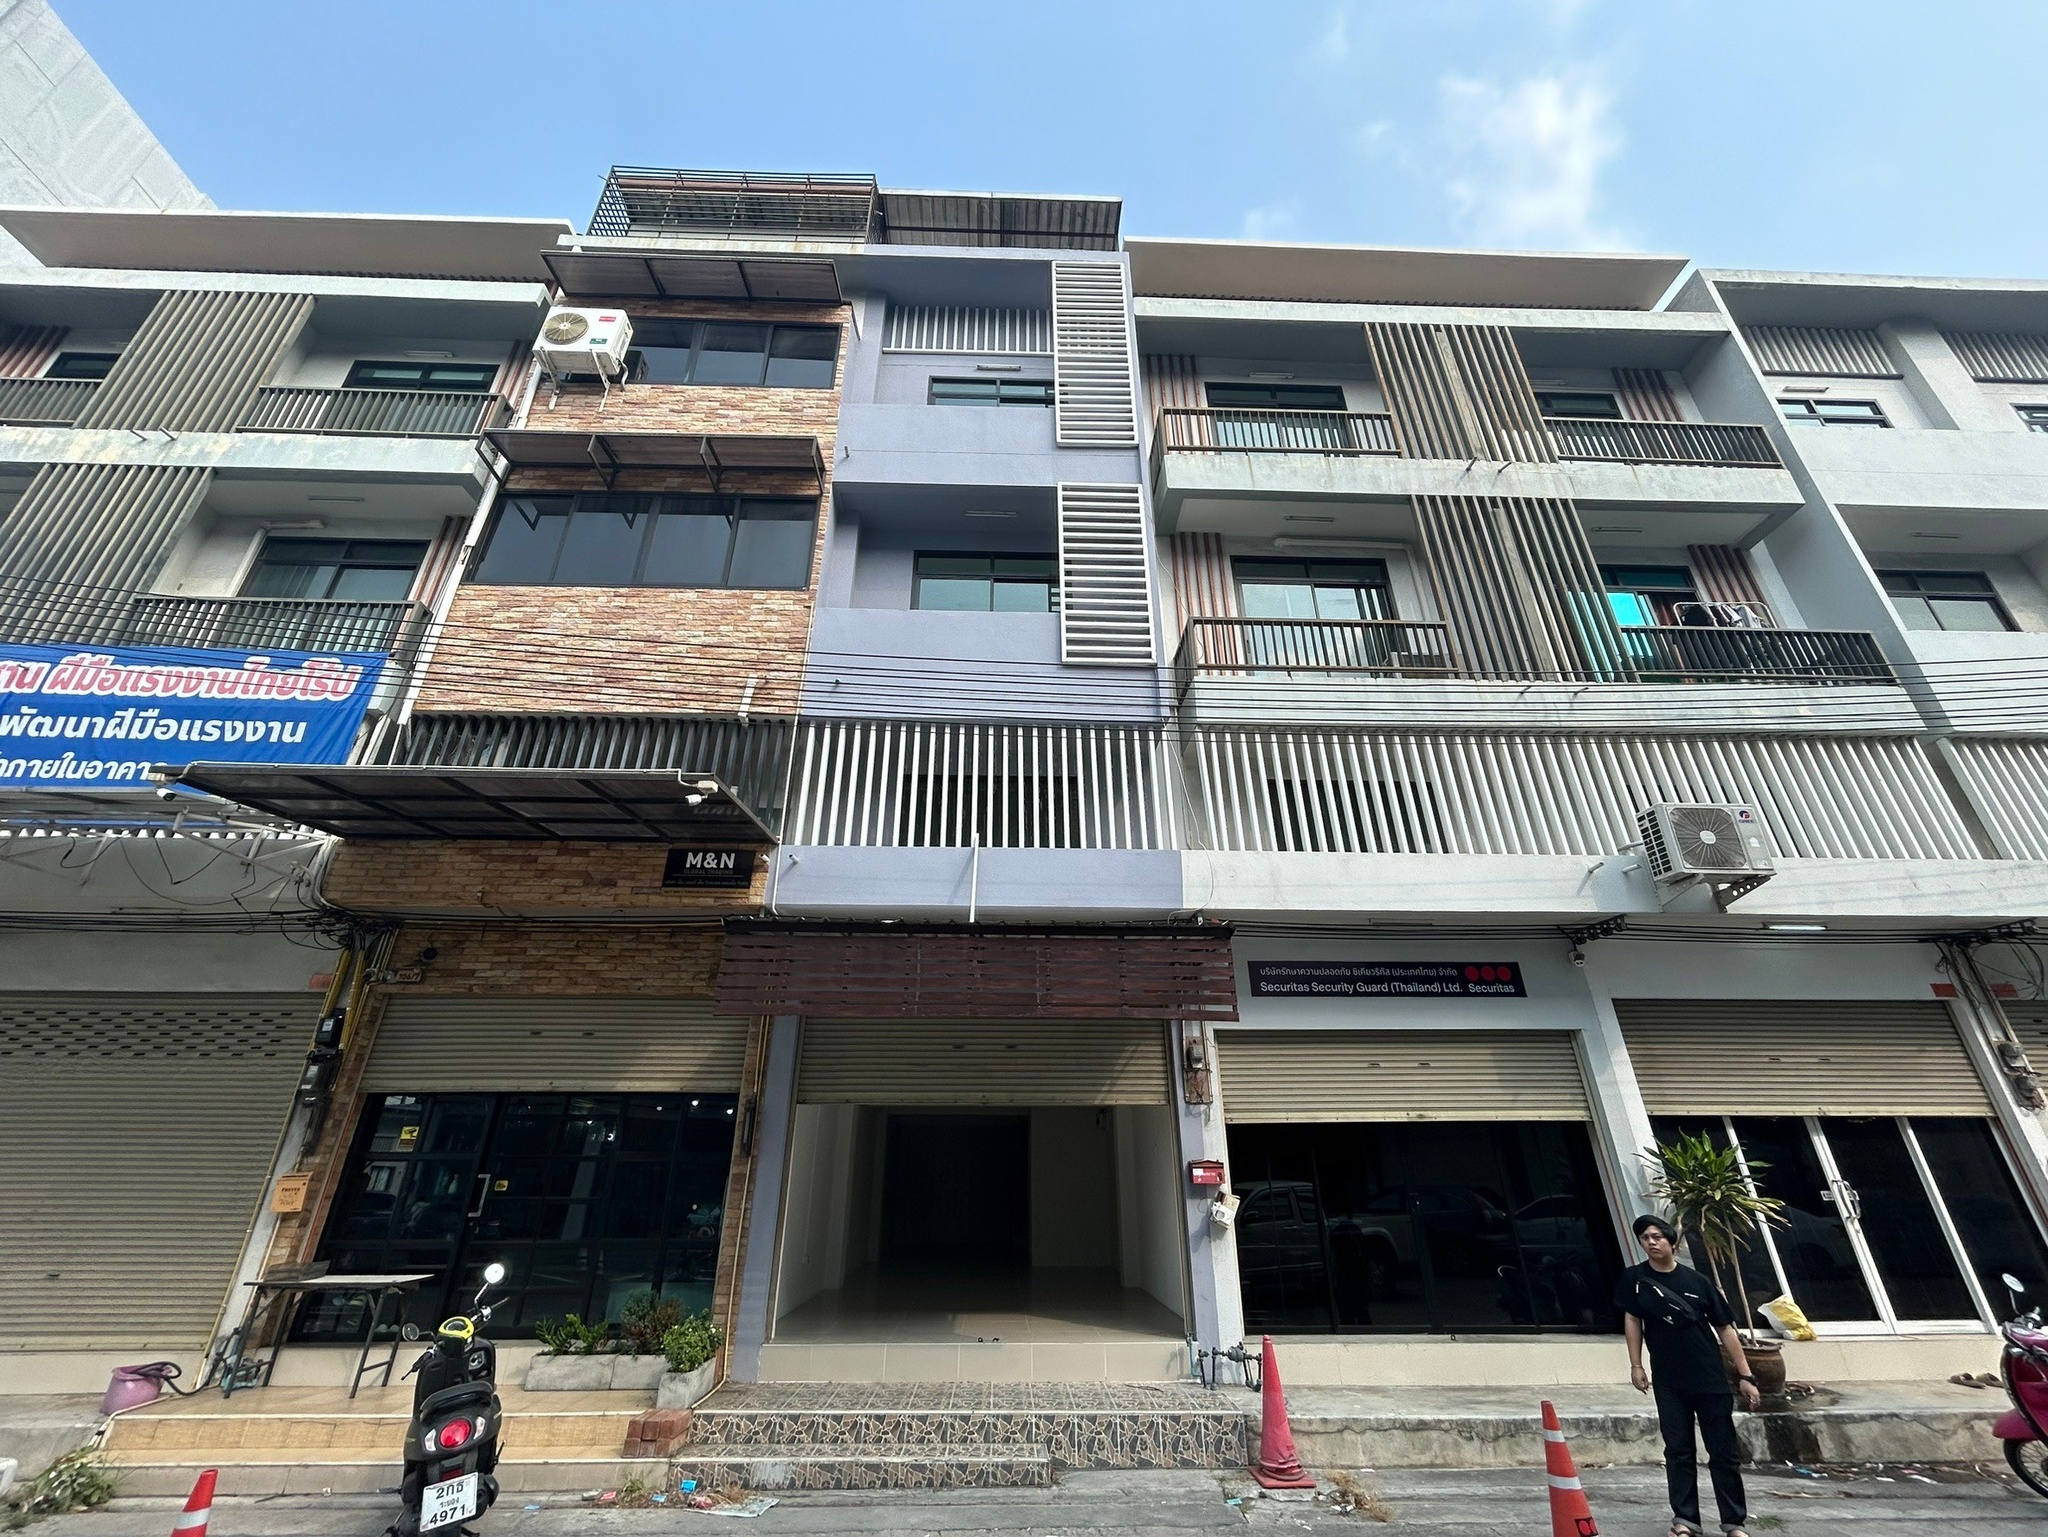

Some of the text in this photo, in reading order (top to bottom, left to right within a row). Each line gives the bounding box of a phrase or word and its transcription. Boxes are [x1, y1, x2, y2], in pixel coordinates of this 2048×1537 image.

[685, 852, 736, 868] M&N
[1391, 966, 1437, 977] (ประเทศไทย)
[1438, 967, 1458, 976] จำกัด
[1260, 981, 1463, 994] Securitas Security Guard (Thailand) Ltd.
[1468, 982, 1515, 993] Securitas
[436, 1481, 464, 1500] 2กธ
[430, 1504, 466, 1525] 4971
